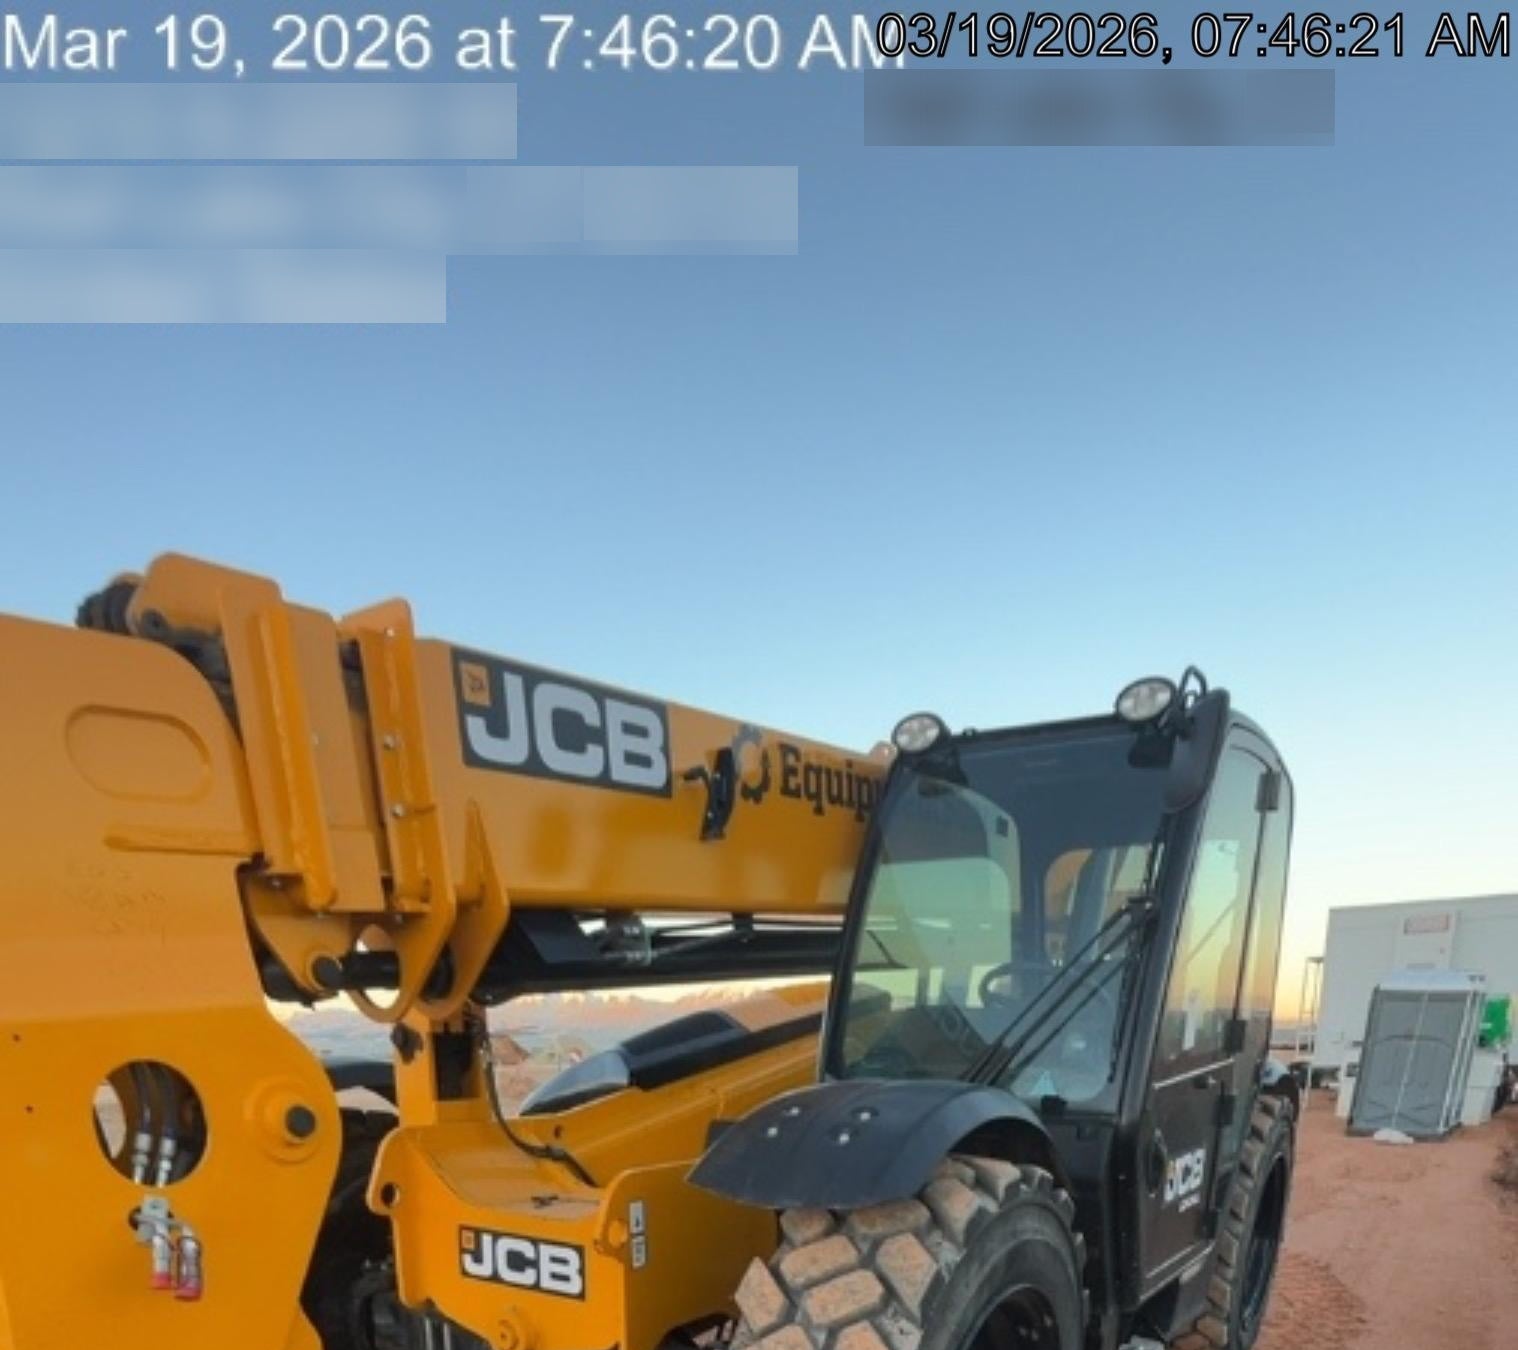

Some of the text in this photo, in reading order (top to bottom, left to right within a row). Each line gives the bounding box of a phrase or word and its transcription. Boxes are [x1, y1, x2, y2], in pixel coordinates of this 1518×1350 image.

[465, 671, 668, 789] JCB
[1164, 1148, 1206, 1202] JCB
[463, 1232, 583, 1296] JCB
